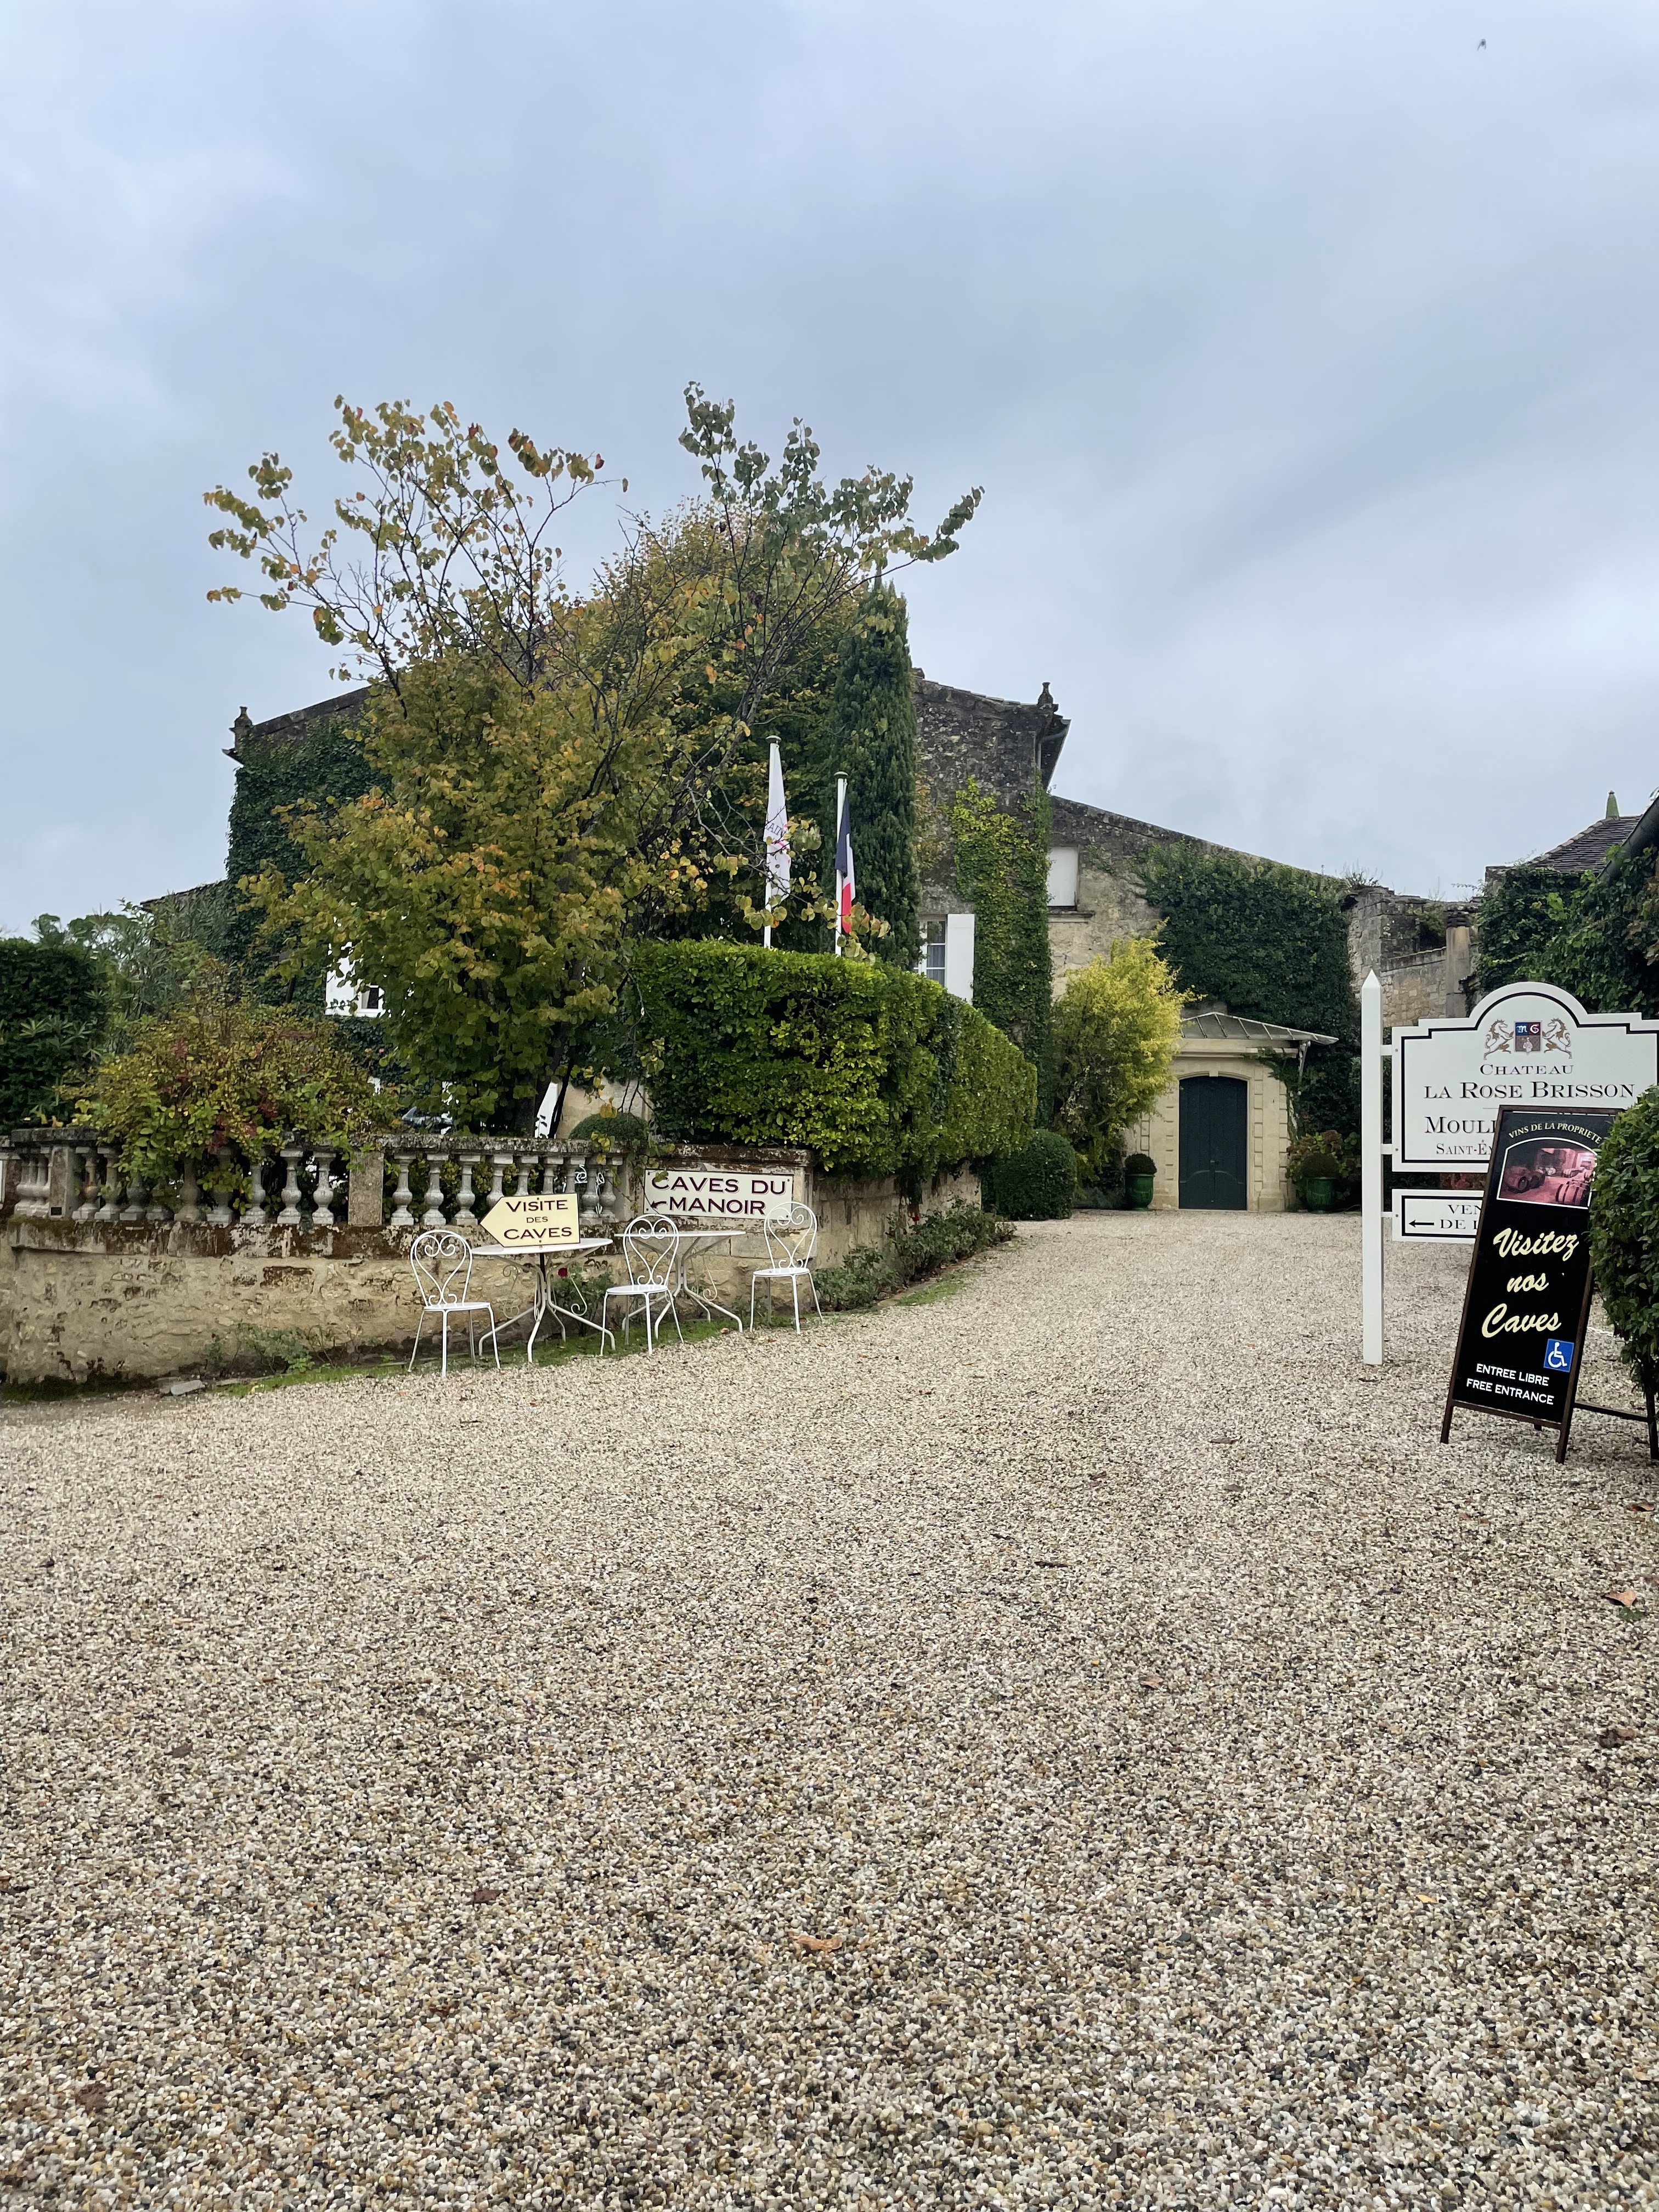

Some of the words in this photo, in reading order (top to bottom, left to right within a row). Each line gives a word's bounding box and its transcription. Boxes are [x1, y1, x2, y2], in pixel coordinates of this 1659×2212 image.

[1480, 1063, 1575, 1076] CHATEAU
[1424, 1086, 1453, 1099] LA
[1460, 1082, 1523, 1099] ROSE
[1530, 1081, 1635, 1098] BRISSON
[1509, 1126, 1529, 1138] VINS
[1531, 1124, 1543, 1132] DE
[1557, 1122, 1602, 1144] PROPRIETE
[651, 1176, 739, 1193] CAVES
[751, 1180, 786, 1195] DU
[505, 1199, 568, 1213] VISITE
[669, 1196, 766, 1216] MANOIR
[504, 1227, 573, 1240] CAVES
[1440, 1219, 1466, 1229] DE
[1493, 1227, 1579, 1262] Visitez
[1506, 1272, 1549, 1293] nos
[1481, 1303, 1562, 1339] Caves
[1476, 1363, 1516, 1380] ENTREE
[1518, 1372, 1550, 1386] LIBRE
[1466, 1378, 1493, 1392] FREE
[1494, 1384, 1555, 1405] ENTRANCE
